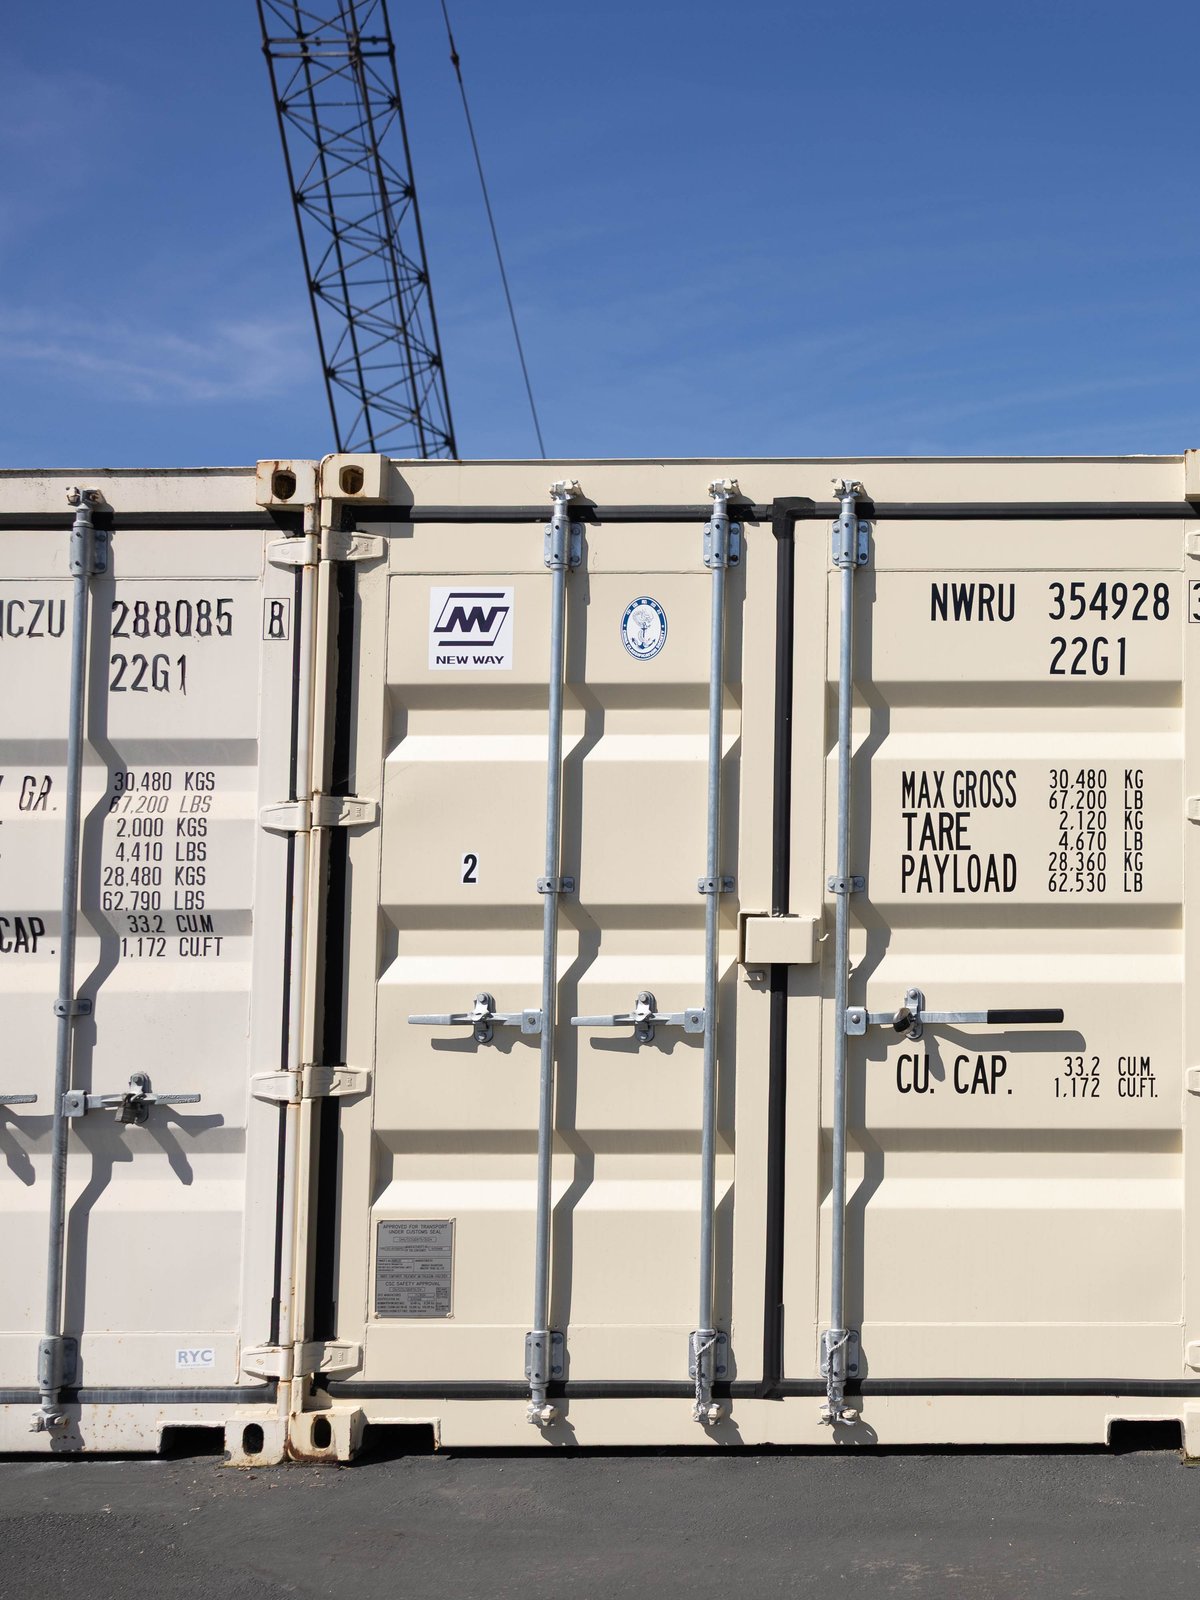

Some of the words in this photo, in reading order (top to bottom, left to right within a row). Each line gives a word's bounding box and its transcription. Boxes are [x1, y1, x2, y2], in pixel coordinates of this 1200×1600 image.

[931, 583, 1015, 622] NWRU
[1049, 582, 1169, 620] 354928
[0, 599, 66, 639] CZU
[111, 598, 234, 638] 288085
[268, 600, 285, 640] 8
[436, 655, 469, 665] NEW
[473, 655, 505, 665] WAY
[1050, 637, 1125, 675] 22G1
[109, 654, 188, 696] 22G1
[113, 771, 173, 794] 30,480
[183, 771, 216, 792] KGS
[902, 771, 945, 808] MAX
[953, 770, 1016, 808] GROSS
[1050, 769, 1106, 789] 30,480
[1125, 769, 1143, 789] KG
[107, 795, 170, 816] 67,200
[179, 795, 212, 814] LBS
[1049, 790, 1106, 809] 67,200
[1125, 790, 1143, 809] LB
[115, 817, 164, 839] 2,000
[176, 817, 208, 838] KGS
[902, 812, 971, 851] TARE
[1060, 811, 1106, 830] 2,120
[1125, 811, 1143, 830] KG
[114, 841, 163, 863] 4,410
[175, 841, 207, 863] LBS
[1059, 831, 1106, 851] 4,670
[1125, 831, 1142, 851] LB
[463, 854, 477, 883] 2
[1049, 852, 1106, 871] 28,360
[1125, 852, 1143, 871] KG
[103, 865, 163, 888] 28,480
[174, 865, 207, 887] KGS
[902, 854, 1016, 893] PAYLOAD
[1049, 872, 1106, 892] 62,530
[1124, 872, 1142, 892] LB
[102, 890, 162, 912] 62,790
[173, 890, 206, 911] LBS
[126, 914, 166, 935] 33.2
[175, 914, 215, 934] CU.M
[121, 936, 166, 959] 1,172
[178, 936, 224, 958] CU.FT
[897, 1054, 935, 1094] CU.
[954, 1054, 1014, 1095] CAP.
[1064, 1056, 1100, 1077] 33.2
[1118, 1056, 1154, 1077] CU.M.
[1055, 1078, 1100, 1098] 1,172
[1118, 1078, 1158, 1098] CU.FT.
[177, 1349, 213, 1364] RYC
